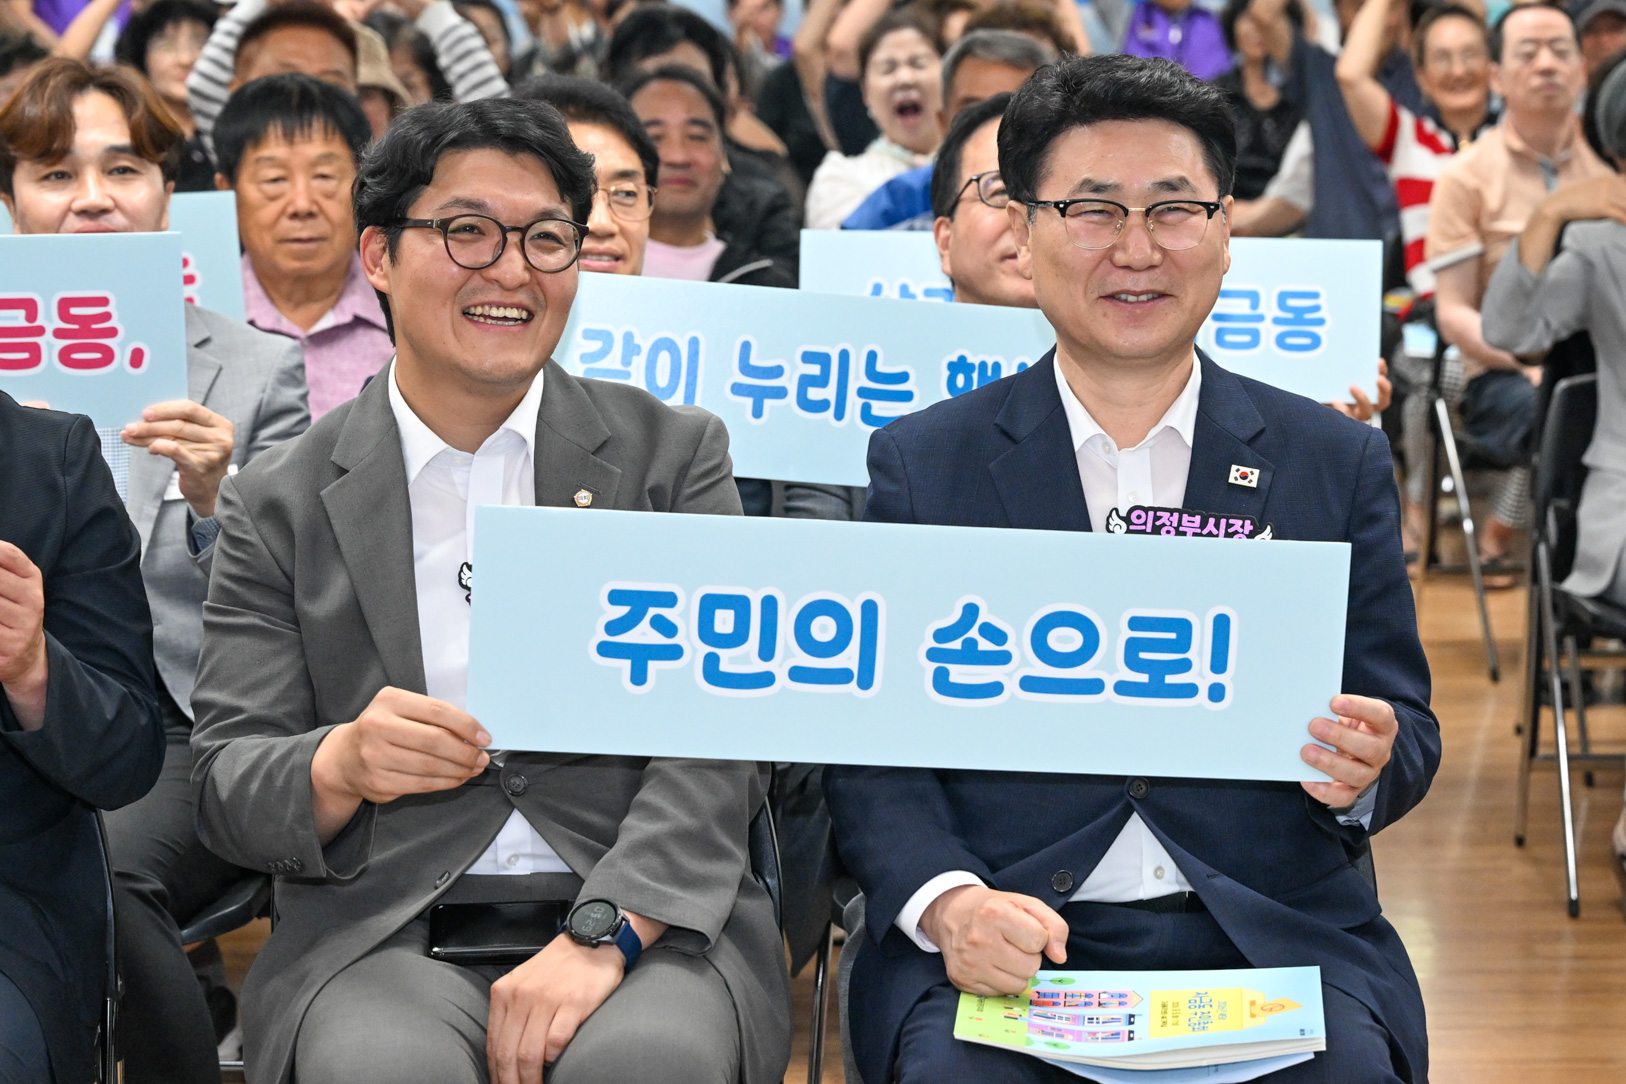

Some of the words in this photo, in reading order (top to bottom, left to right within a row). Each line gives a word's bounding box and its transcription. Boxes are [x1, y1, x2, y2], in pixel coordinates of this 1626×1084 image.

[731, 340, 914, 427] 누리는
[1129, 509, 1254, 539] 의정부시장
[596, 588, 878, 690] 주민의
[925, 602, 1231, 703] 손으로!
